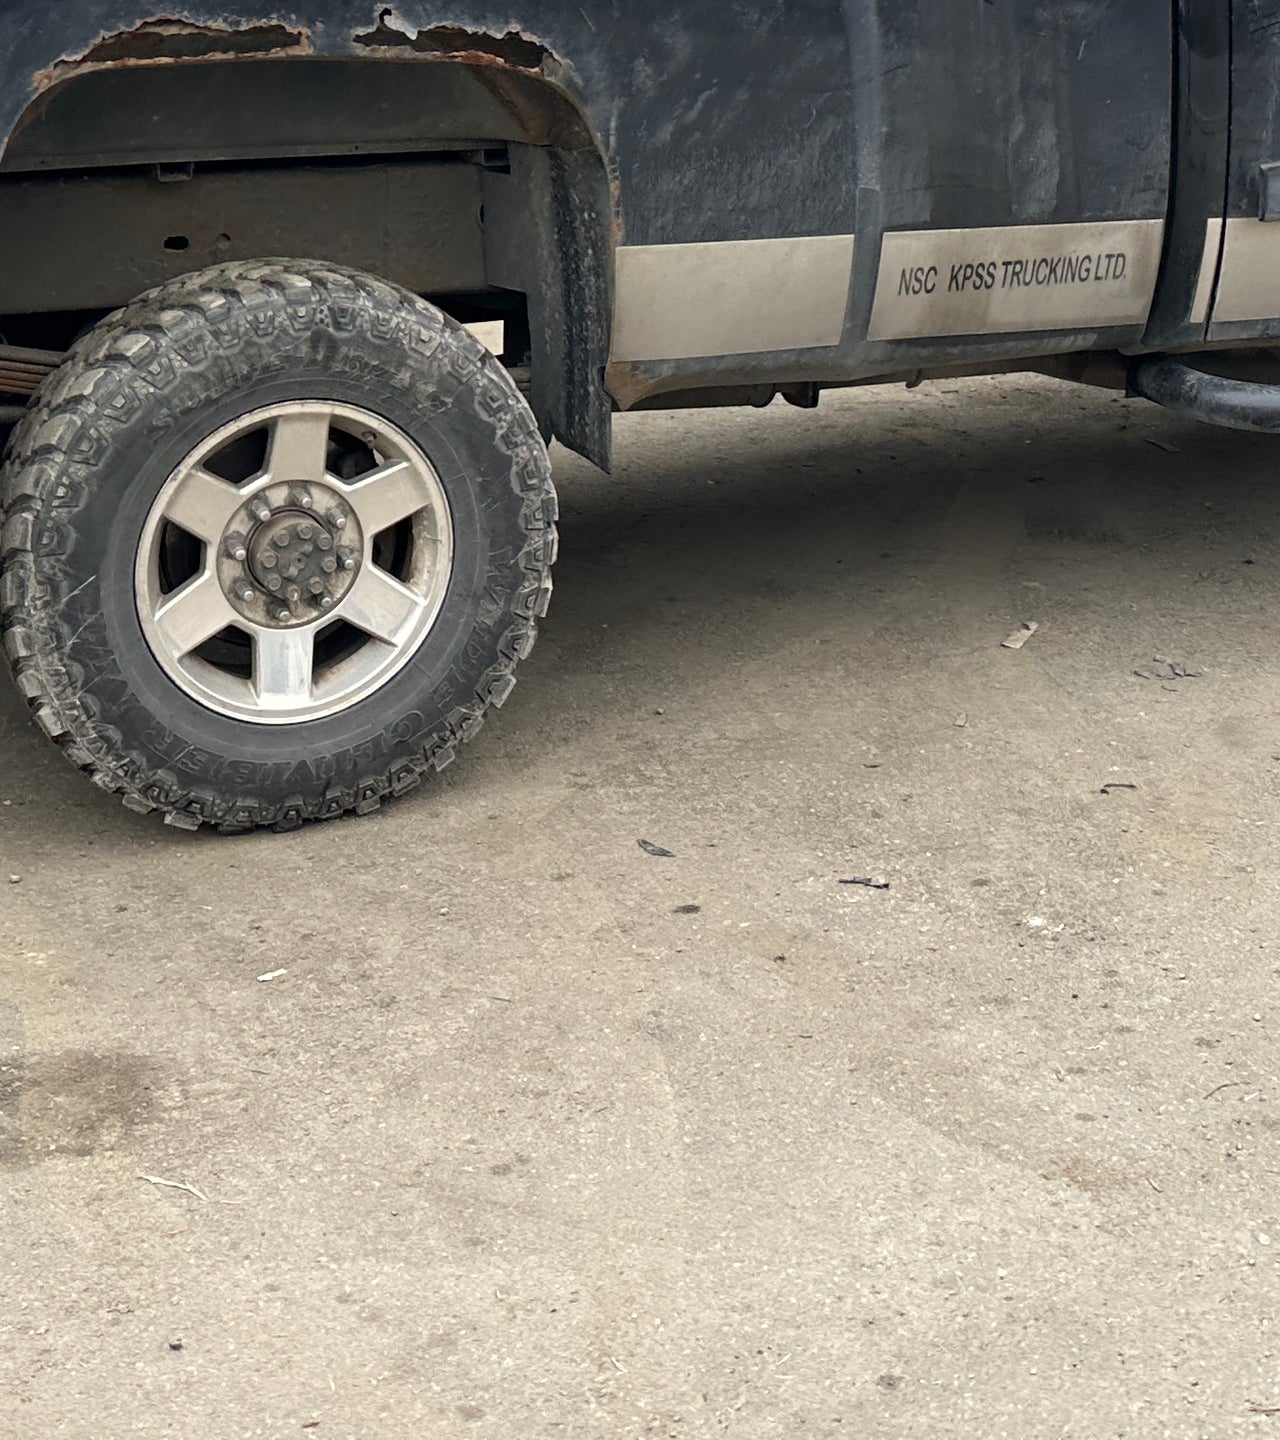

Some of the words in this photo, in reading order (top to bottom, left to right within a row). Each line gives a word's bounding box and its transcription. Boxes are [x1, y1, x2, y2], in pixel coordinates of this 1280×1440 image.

[897, 265, 937, 296] NSC
[947, 261, 997, 292] KPSS
[1002, 254, 1091, 289] TRUCKING
[1094, 252, 1126, 281] LTD.
